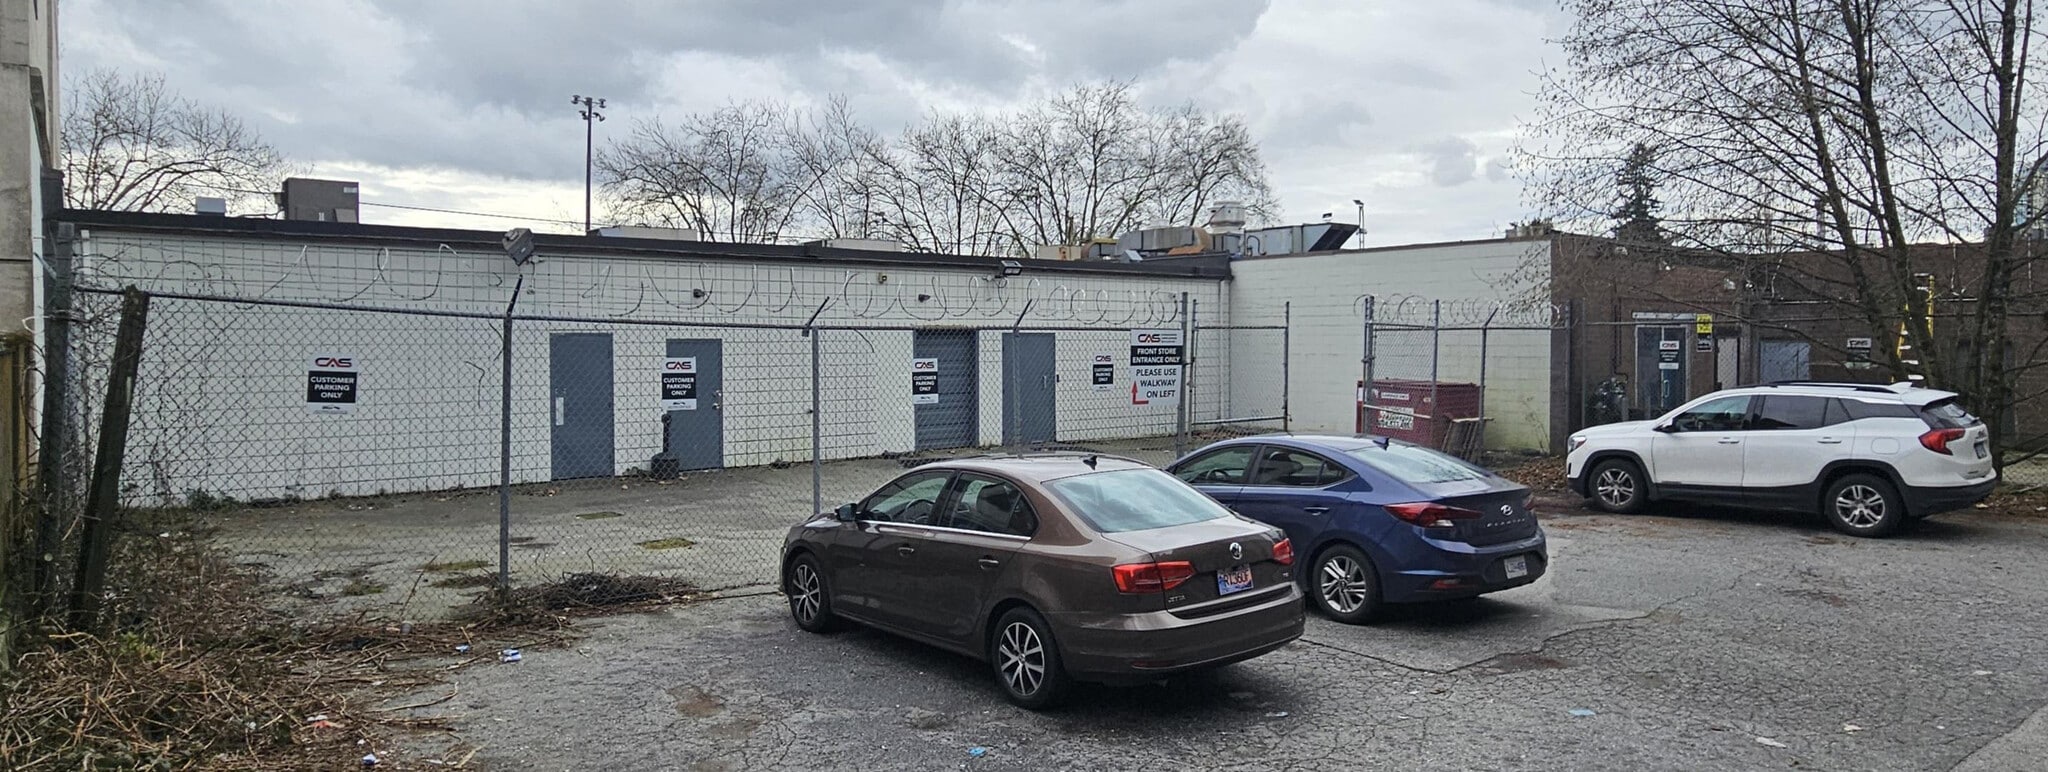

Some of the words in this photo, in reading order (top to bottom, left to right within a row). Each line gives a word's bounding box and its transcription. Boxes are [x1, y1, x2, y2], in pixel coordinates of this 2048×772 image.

[1138, 333, 1161, 343] CAS
[1137, 347, 1157, 355] FRONT
[1158, 347, 1177, 355] STORE
[315, 357, 352, 367] CAS
[1132, 356, 1164, 364] ENTRANCE
[666, 361, 692, 370] CAS
[915, 361, 935, 369] CAS
[1136, 368, 1162, 376] PLEASE
[1164, 368, 1177, 376] USE
[310, 376, 355, 384] CUSTOMER
[1140, 379, 1176, 387] WALKWAY
[314, 383, 350, 391] PARKING
[320, 391, 343, 399] ONLY
[1146, 390, 1158, 398] ON
[1160, 389, 1176, 397] LEFT
